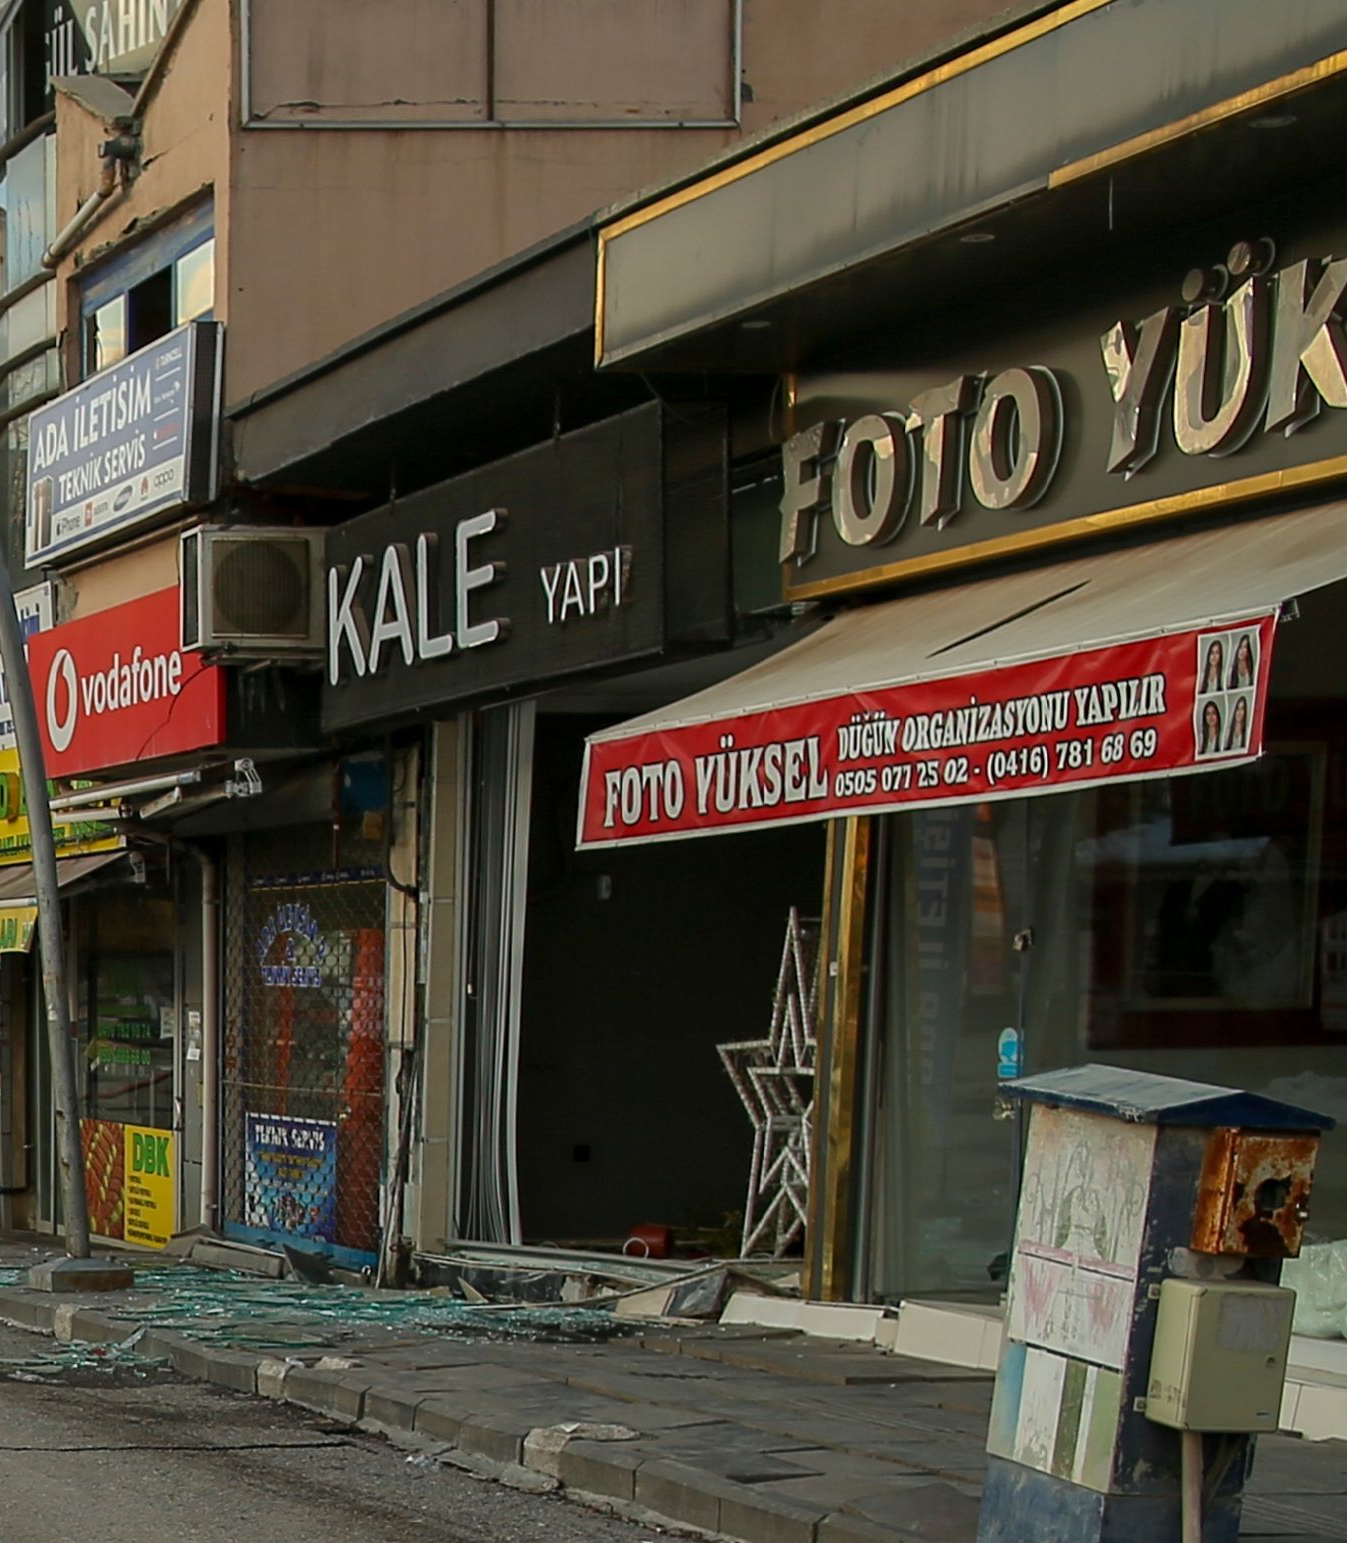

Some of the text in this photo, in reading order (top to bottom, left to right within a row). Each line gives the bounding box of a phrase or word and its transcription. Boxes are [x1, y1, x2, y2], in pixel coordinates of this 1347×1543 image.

[33, 415, 69, 474] ADA
[58, 453, 102, 504] TEKNİK
[103, 429, 146, 484] SERVİS
[779, 365, 1054, 565] FOTO
[328, 508, 622, 687] KALE YAPI
[81, 645, 182, 717] vodafone
[837, 674, 1166, 762] DÜĞÜN ORGANİZASYONU YAPILIR
[603, 734, 828, 828] FOTO YÜKSEL
[834, 768, 878, 797] 0505
[881, 764, 912, 792] 077
[916, 760, 939, 787] 25
[943, 757, 969, 784] 02
[986, 745, 1049, 785] (0416)
[1055, 738, 1094, 769] 781
[1100, 733, 1124, 763] 68
[1129, 728, 1157, 758] 69
[132, 1132, 170, 1178] DBK
